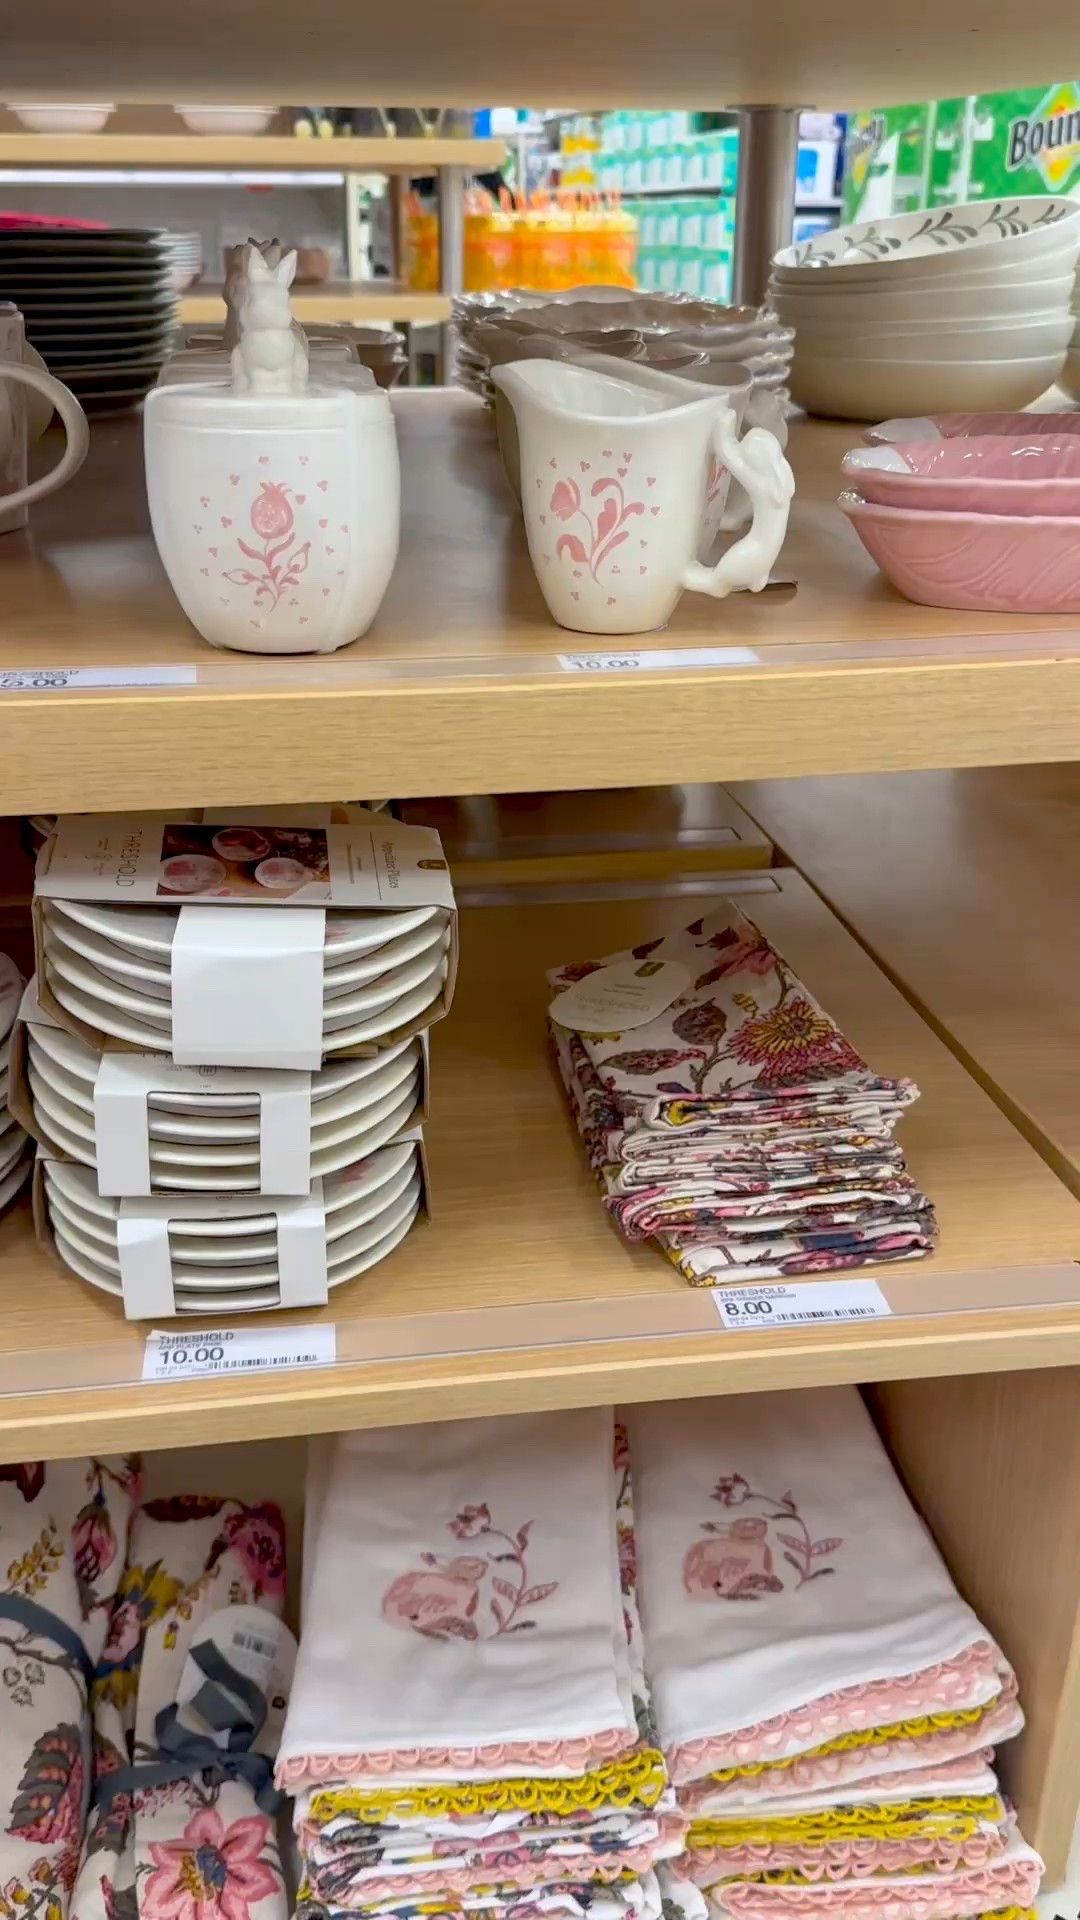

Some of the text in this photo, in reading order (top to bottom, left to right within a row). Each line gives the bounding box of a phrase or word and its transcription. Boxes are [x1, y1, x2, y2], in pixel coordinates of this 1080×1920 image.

[572, 659, 640, 670] 10.00
[116, 829, 143, 887] THRESHOLD
[719, 1286, 786, 1298] THRESHOLD
[724, 1300, 773, 1316] 8.00
[159, 1331, 235, 1345] THRESHOLD
[159, 1347, 225, 1365] 10.00
